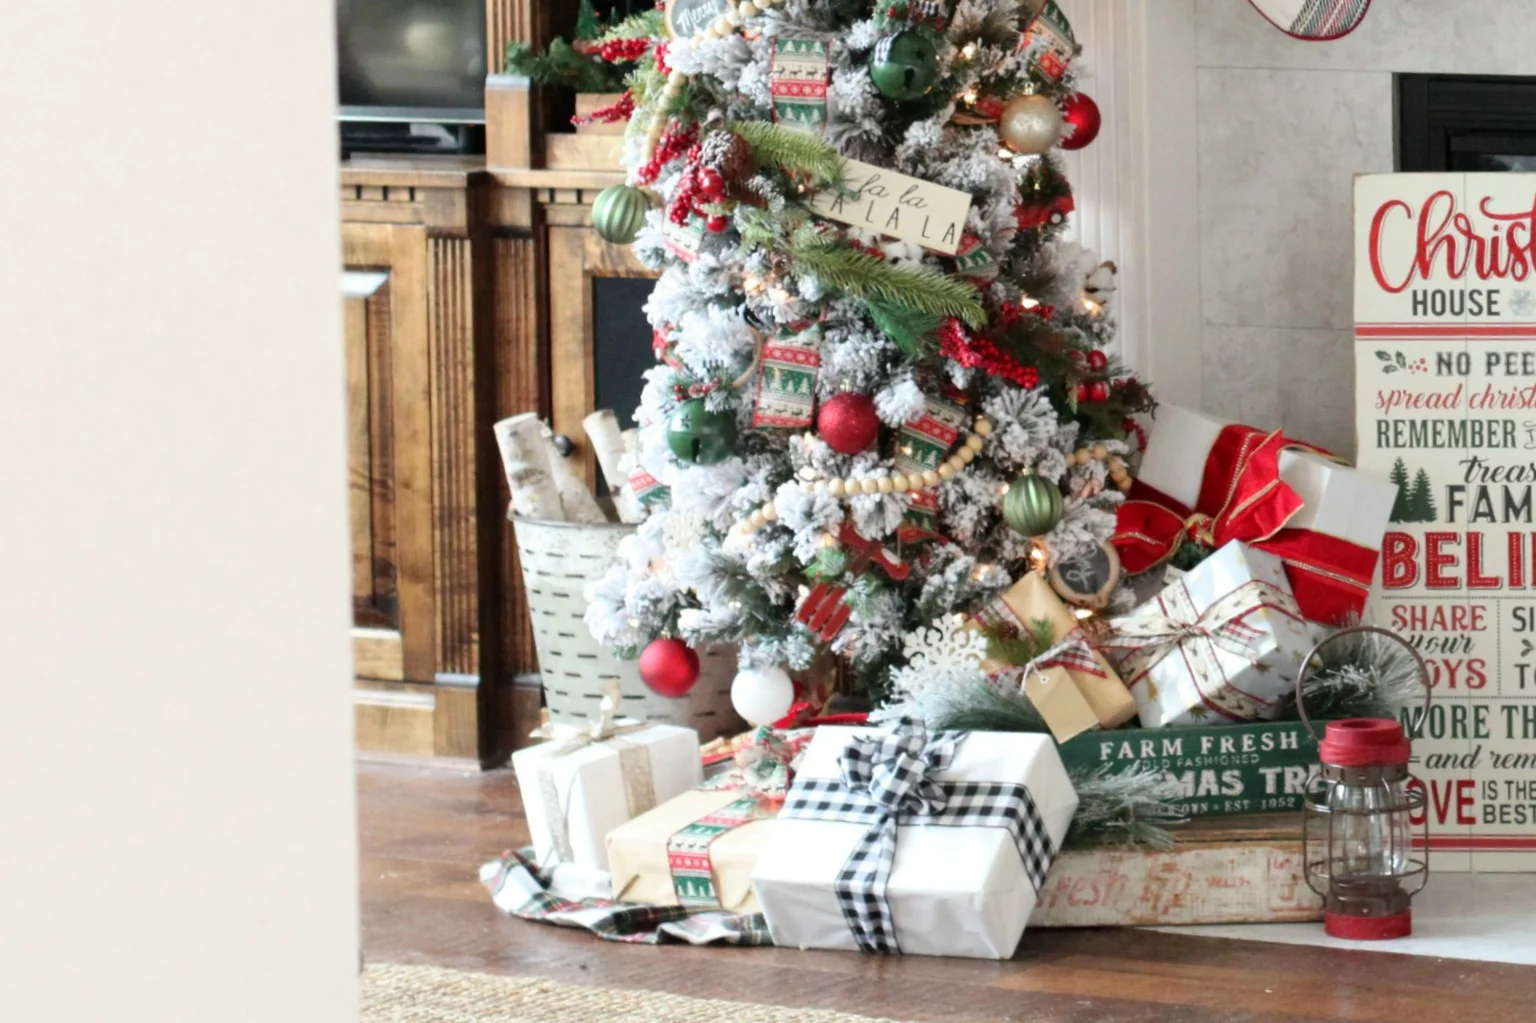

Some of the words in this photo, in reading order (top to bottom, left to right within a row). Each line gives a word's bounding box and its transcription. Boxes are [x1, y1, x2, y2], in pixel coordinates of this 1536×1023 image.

[900, 184, 929, 209] la
[865, 199, 900, 231] LA
[921, 215, 956, 246] LA
[1412, 288, 1501, 317] HOUSE
[1435, 351, 1472, 376] NO
[1374, 382, 1463, 415] spread
[1376, 418, 1517, 448] REMEMBER
[1391, 604, 1488, 632] SHARE
[1421, 658, 1488, 689] OYS
[1401, 704, 1490, 739] MORE
[1100, 738, 1183, 761] FARM
[1200, 732, 1298, 756] FRESH
[1177, 754, 1261, 768] FASHIONED
[1425, 744, 1482, 769] and
[1224, 799, 1251, 812] EST
[1260, 796, 1296, 810] 1952
[1405, 778, 1477, 826] OVE
[1482, 780, 1498, 801] IS
